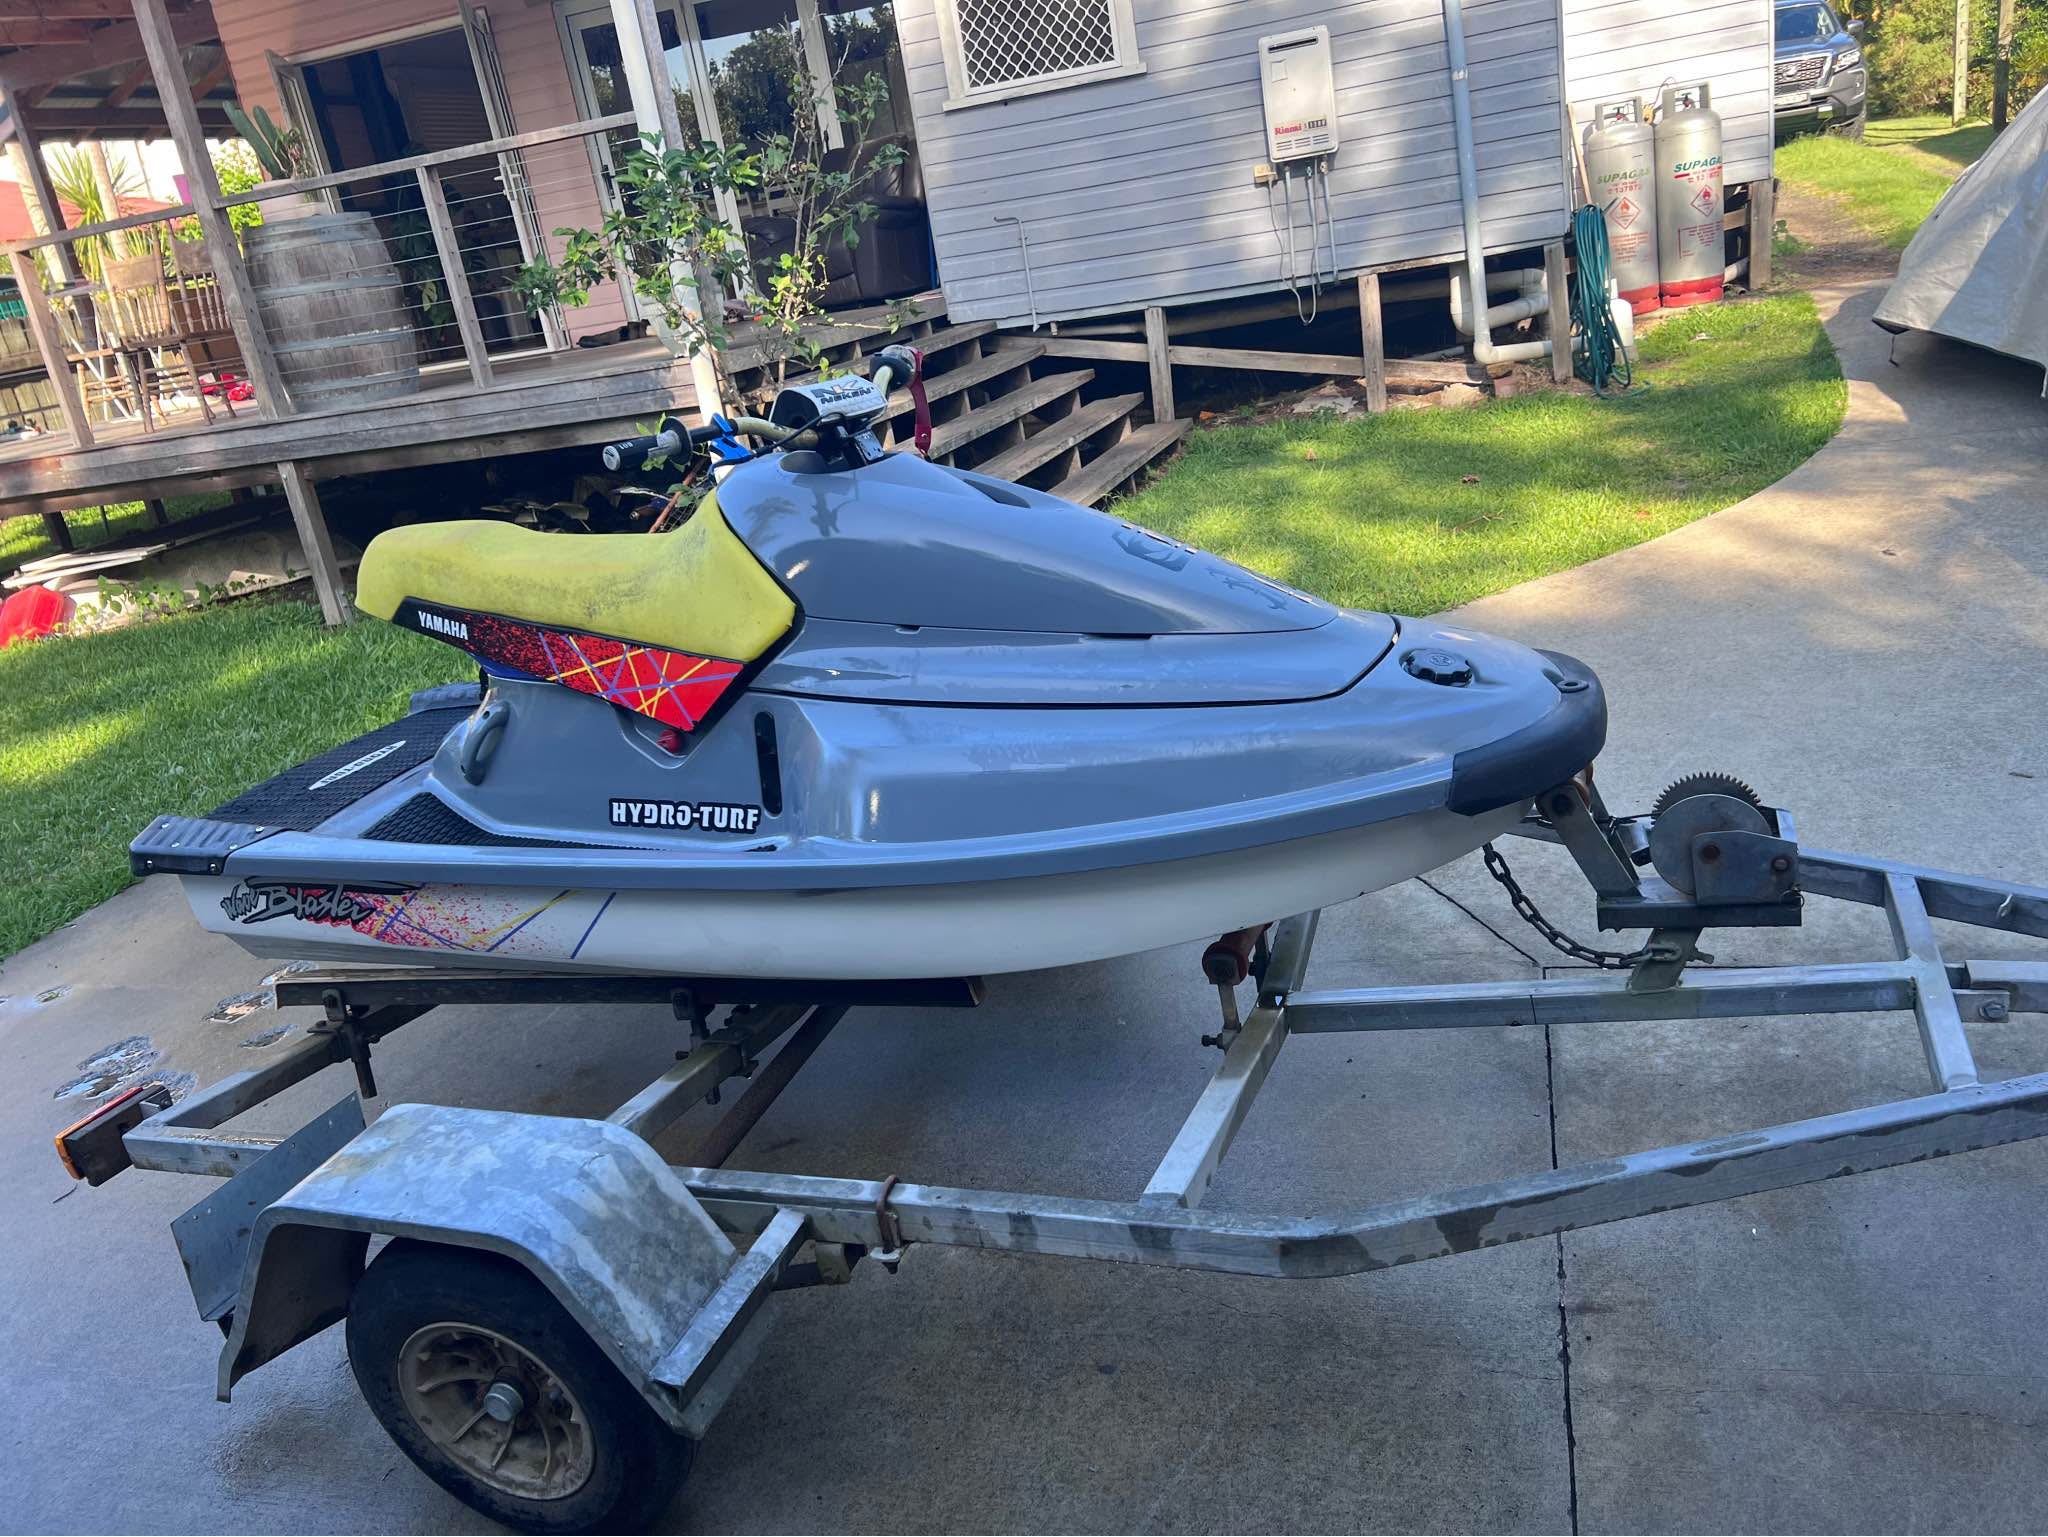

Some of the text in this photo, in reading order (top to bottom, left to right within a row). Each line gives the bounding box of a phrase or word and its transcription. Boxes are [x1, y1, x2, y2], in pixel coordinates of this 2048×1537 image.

[1674, 156, 1722, 172] SUPAGA
[821, 387, 871, 405] NEKEN
[418, 610, 468, 640] YAMAHA
[612, 802, 758, 830] HYDRO-TURF
[243, 883, 377, 925] Blaster
